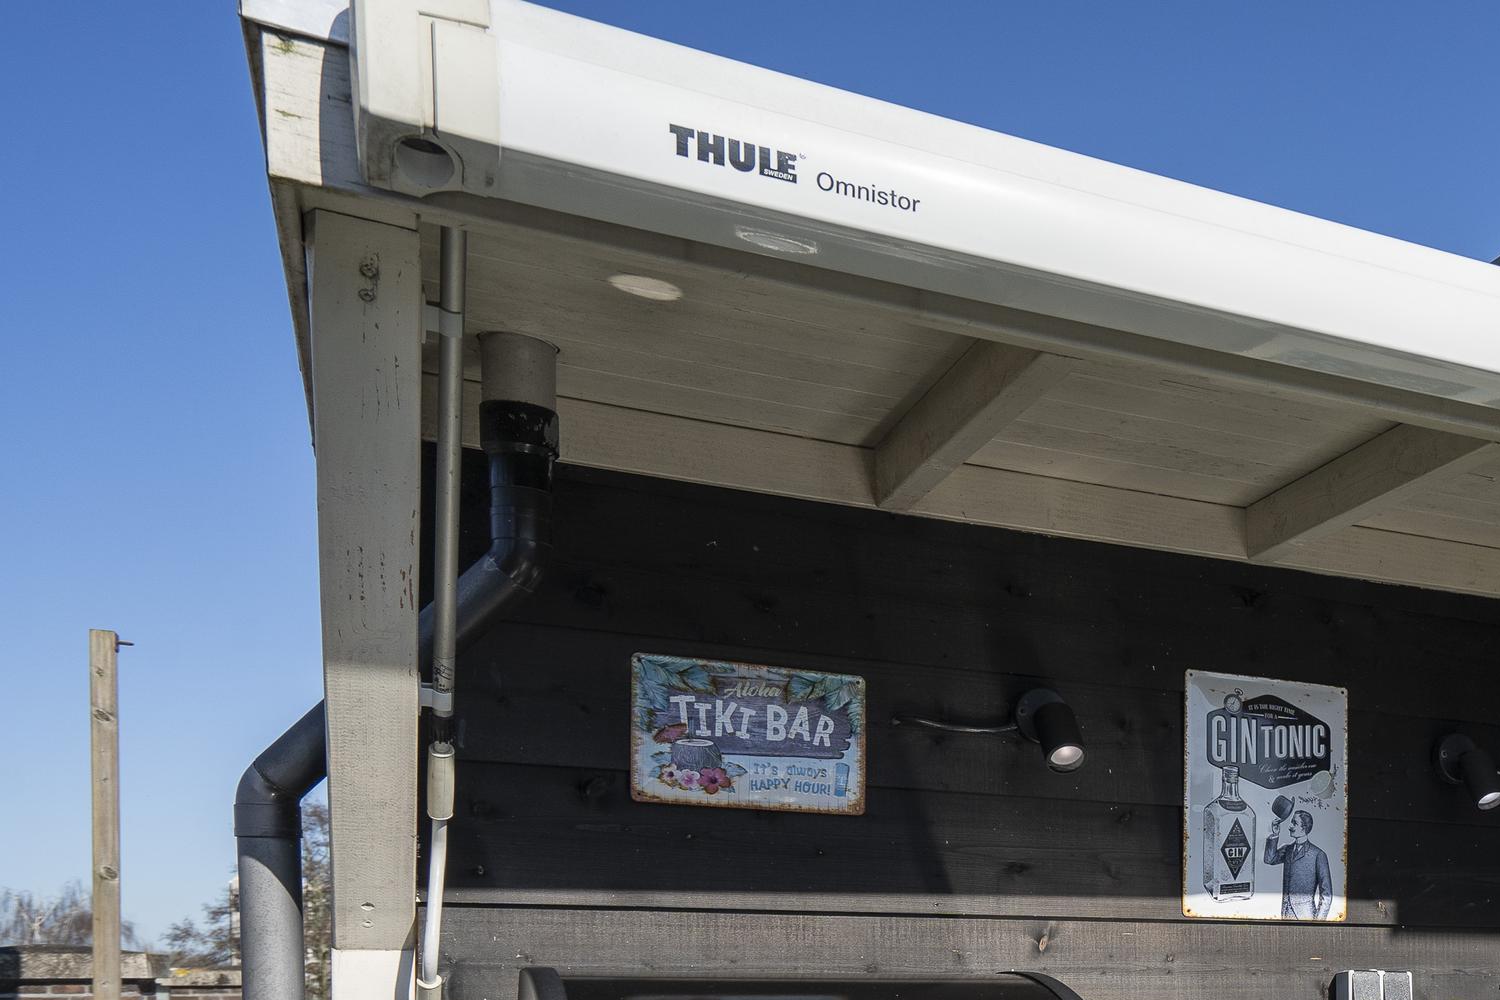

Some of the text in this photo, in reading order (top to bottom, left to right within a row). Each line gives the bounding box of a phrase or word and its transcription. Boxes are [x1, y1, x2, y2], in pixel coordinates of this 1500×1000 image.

[669, 123, 798, 174] THULE
[763, 168, 794, 182] SWEDEN
[816, 171, 921, 212] Omnistor
[723, 680, 783, 699] Aloha
[1269, 704, 1284, 712] RIGHT
[669, 694, 836, 747] TIKI BAR
[1211, 714, 1326, 765] GIN TONIC
[752, 762, 828, 780] It's always
[1268, 775, 1275, 784] &
[750, 777, 832, 797] HAPPY HOUR!
[1227, 847, 1244, 858] GIN
